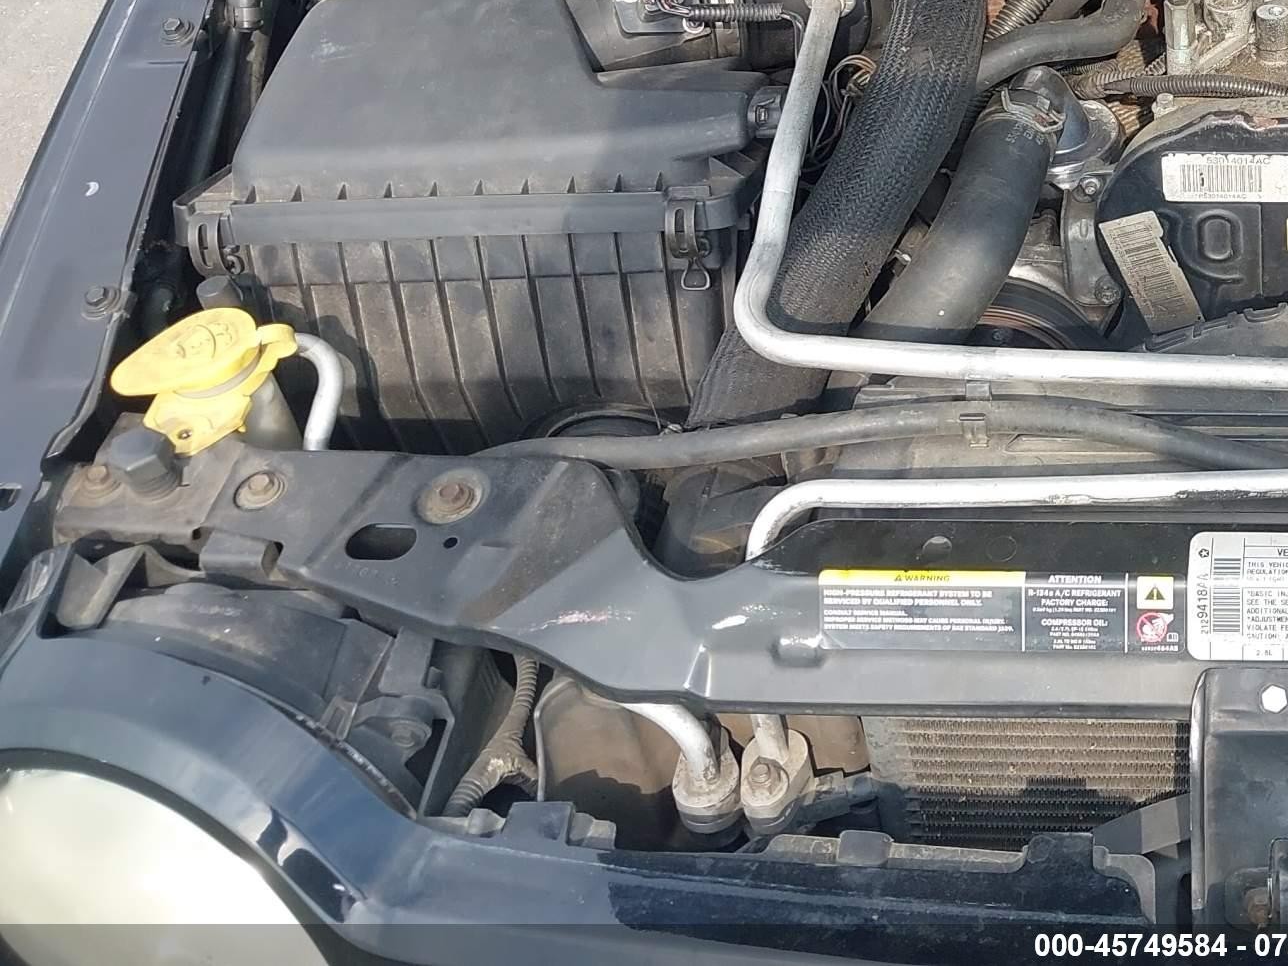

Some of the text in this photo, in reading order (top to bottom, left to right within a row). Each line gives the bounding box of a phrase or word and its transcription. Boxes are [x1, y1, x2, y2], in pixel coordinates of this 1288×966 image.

[1048, 575, 1102, 584] ATTENTION
[1055, 590, 1070, 598] A/C
[1041, 618, 1092, 626] COMPRESSOR
[1247, 624, 1277, 632] VIOLATE
